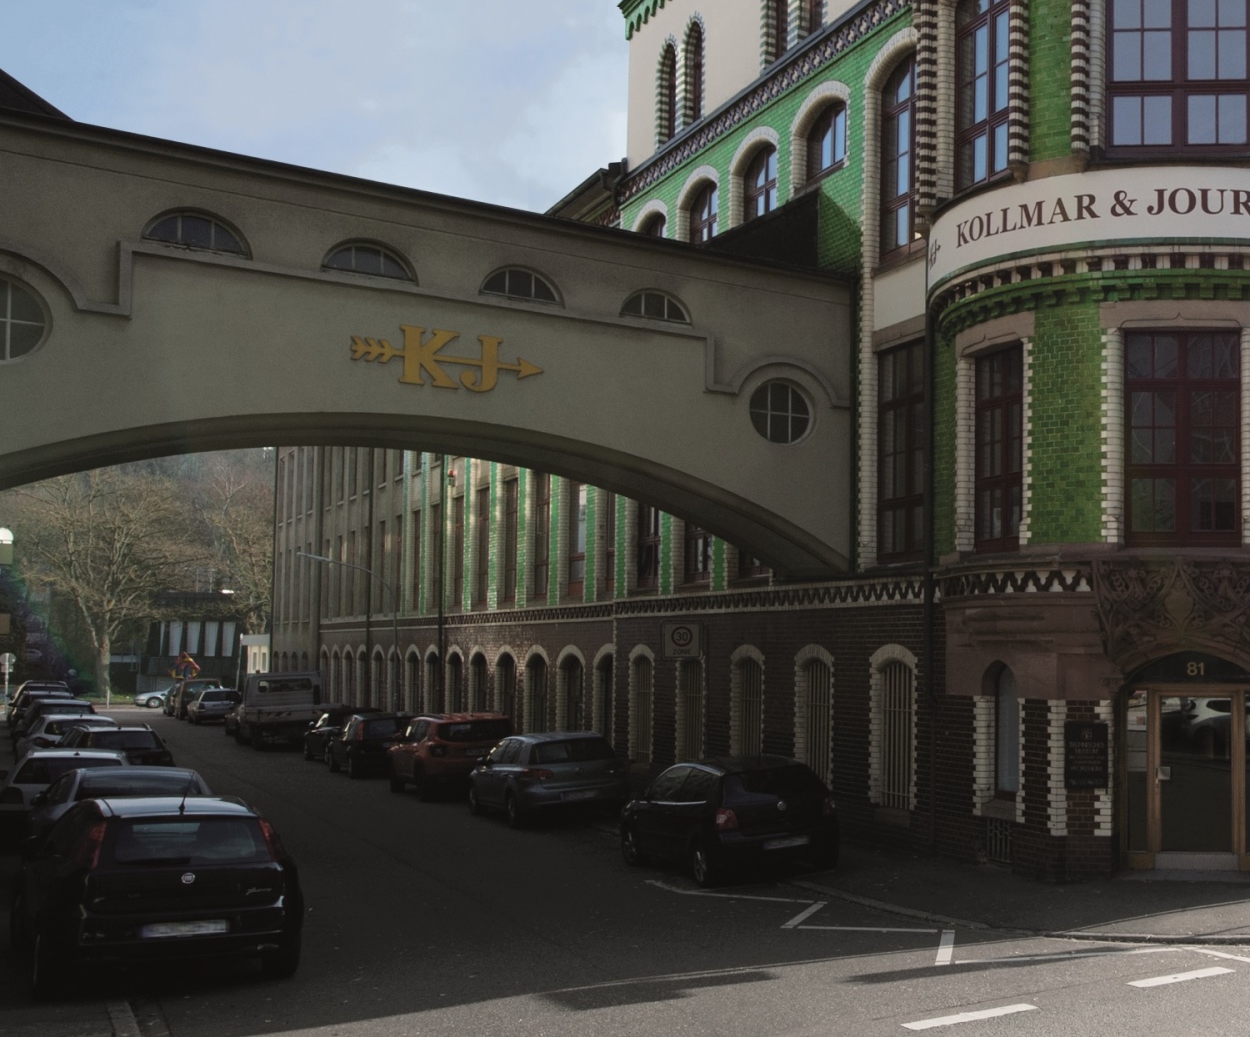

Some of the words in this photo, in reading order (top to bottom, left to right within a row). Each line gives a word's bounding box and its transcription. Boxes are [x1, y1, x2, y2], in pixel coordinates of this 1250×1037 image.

[955, 193, 1100, 249] KOLLMAR
[1110, 190, 1138, 217] &
[399, 325, 504, 392] KJ
[676, 631, 689, 641] 30
[1186, 661, 1205, 676] 81
